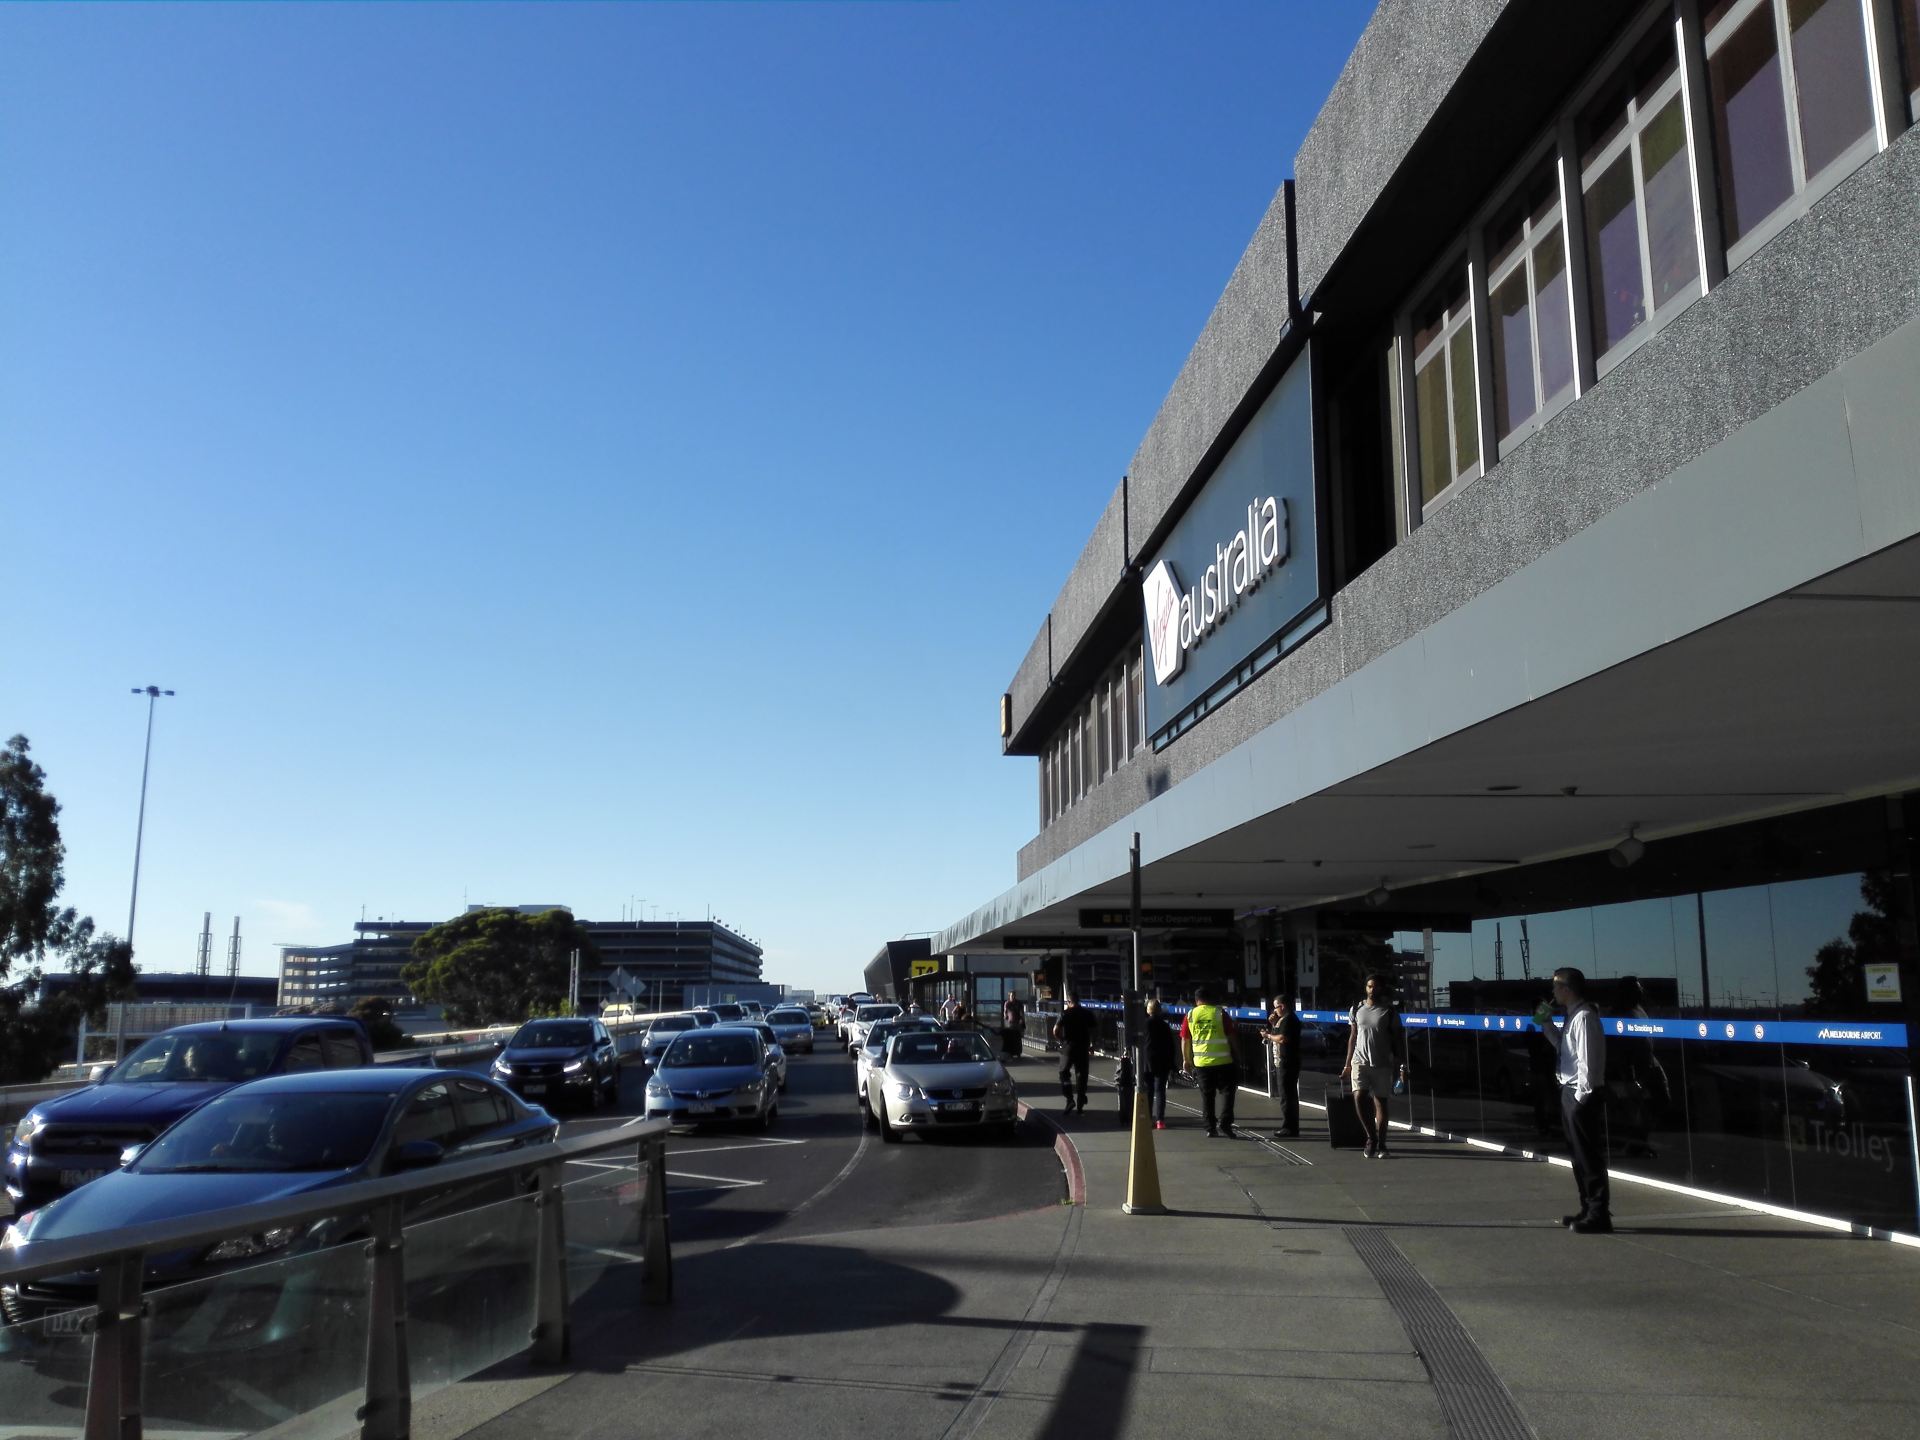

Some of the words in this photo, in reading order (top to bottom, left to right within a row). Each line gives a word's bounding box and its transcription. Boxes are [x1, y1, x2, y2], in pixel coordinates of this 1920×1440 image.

[1180, 496, 1278, 649] australia
[1627, 1024, 1634, 1032] No
[1634, 1024, 1653, 1034] Smoking
[1653, 1025, 1664, 1033] Area
[1829, 1030, 1861, 1039] MELBOURNE
[1861, 1031, 1881, 1040] AIRPORT
[1810, 1120, 1894, 1173] Trolley
